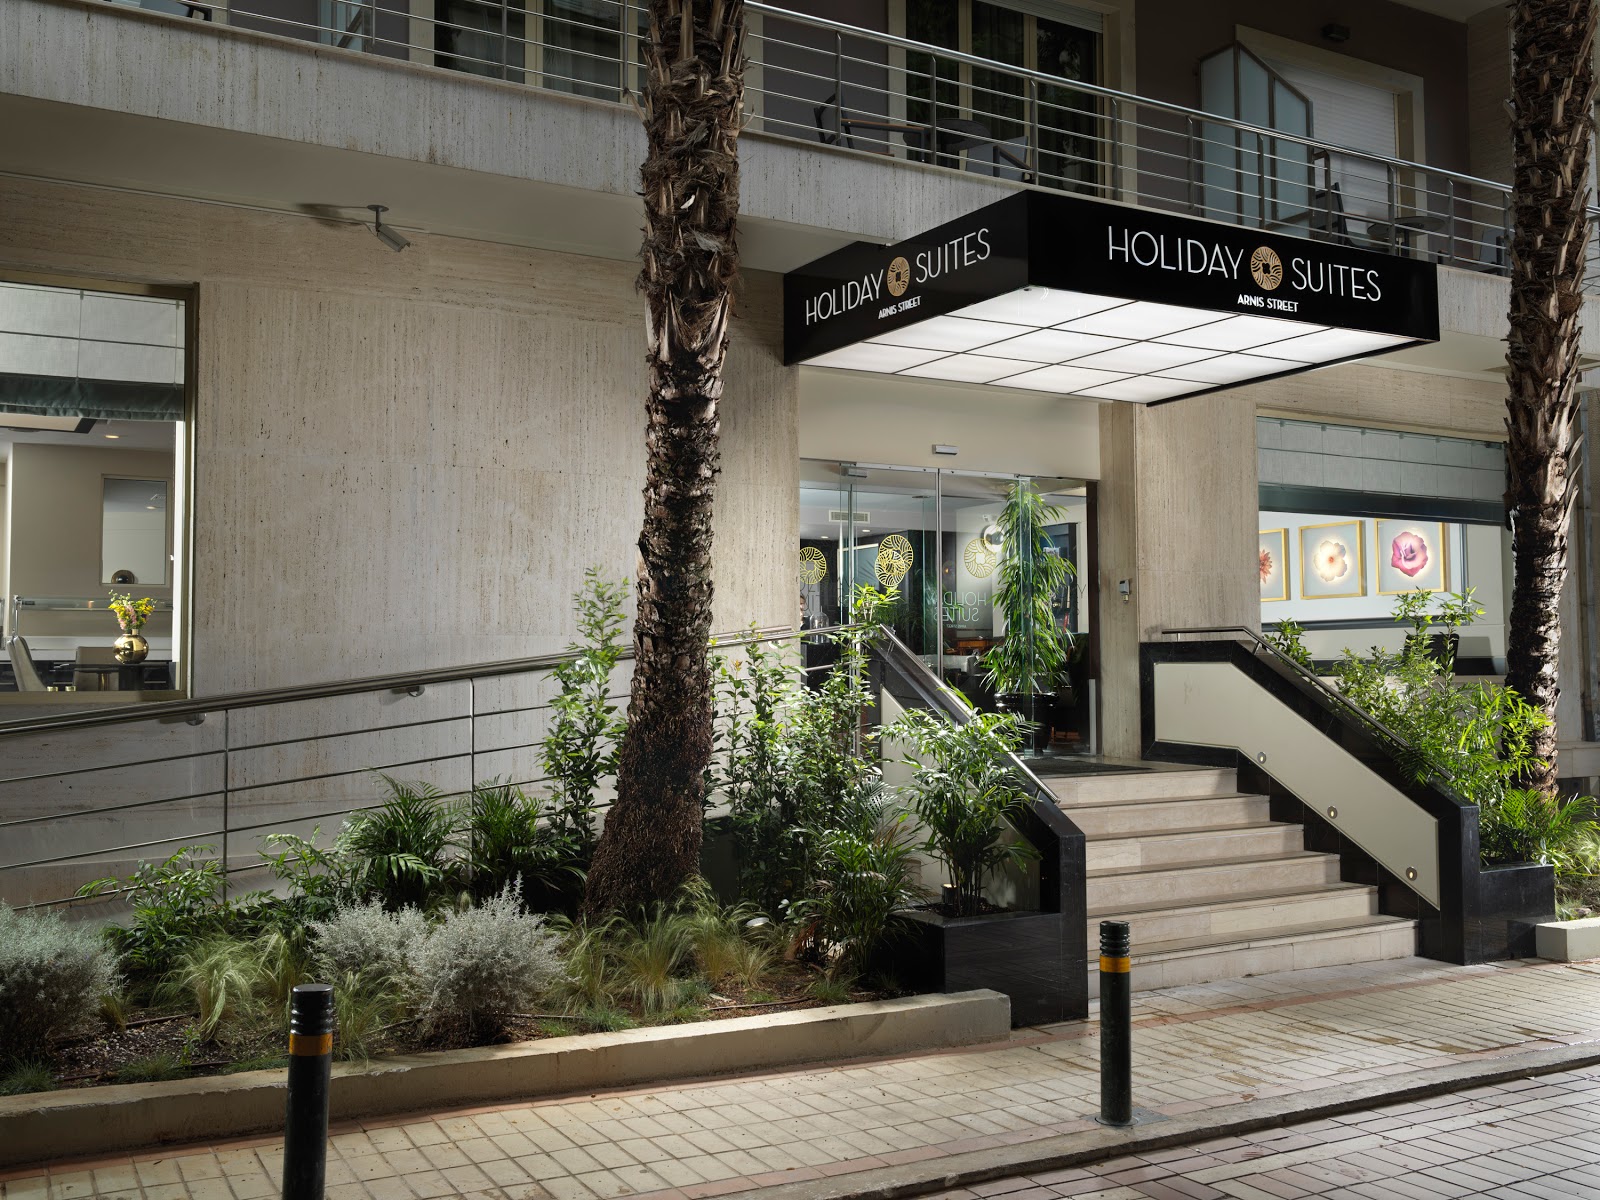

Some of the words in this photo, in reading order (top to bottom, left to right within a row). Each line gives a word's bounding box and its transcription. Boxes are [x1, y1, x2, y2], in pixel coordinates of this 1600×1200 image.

[805, 268, 883, 325] HOLIDAY
[915, 227, 990, 283] SUITES
[1108, 225, 1243, 279] HOLIDAY
[1291, 257, 1381, 301] SUITES
[877, 304, 897, 319] ARNIS
[897, 295, 921, 312] STREET
[1237, 293, 1264, 307] ARNIS
[1266, 297, 1298, 312] STREET
